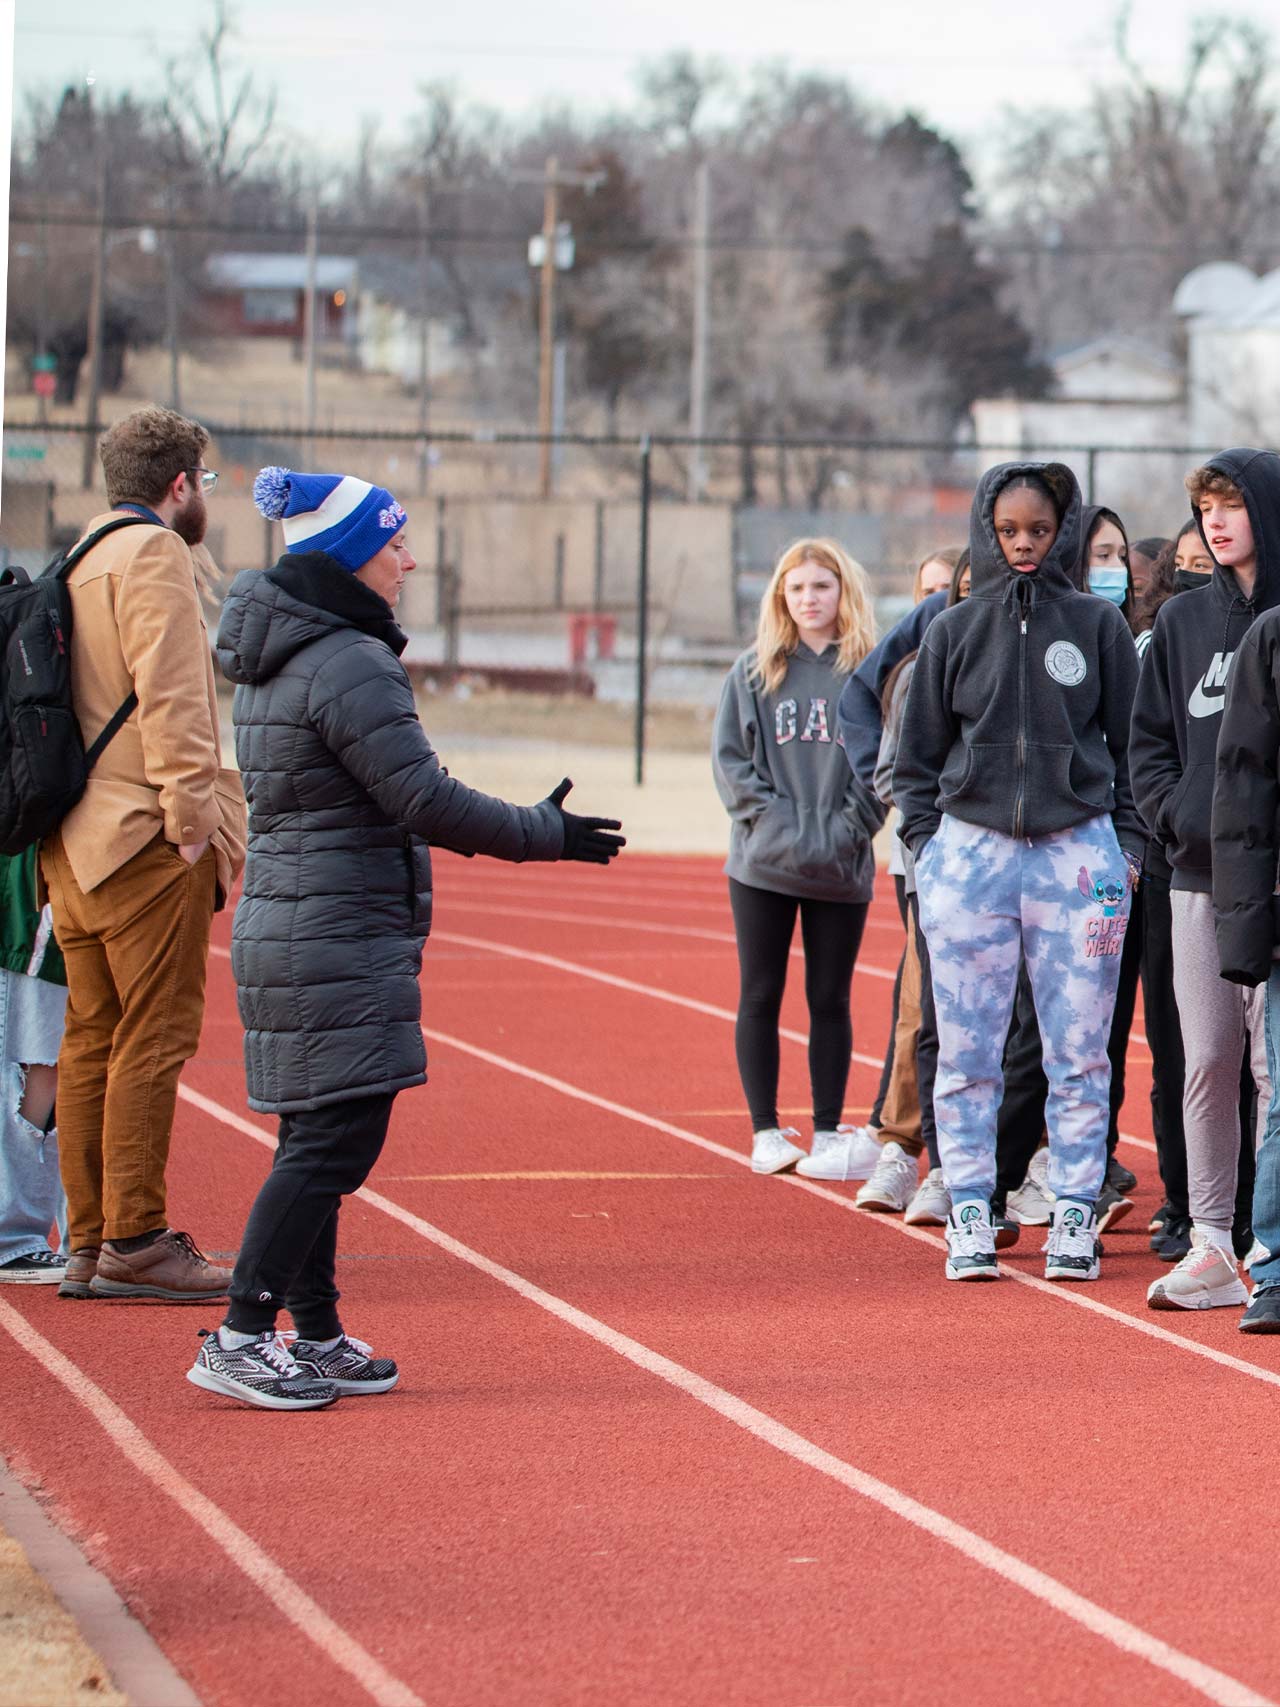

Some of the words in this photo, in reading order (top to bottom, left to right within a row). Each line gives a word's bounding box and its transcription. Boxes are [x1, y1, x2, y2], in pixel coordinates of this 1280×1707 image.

[775, 698, 844, 746] GA
[1085, 915, 1128, 938] CUTE
[1083, 939, 1121, 958] WEIR
